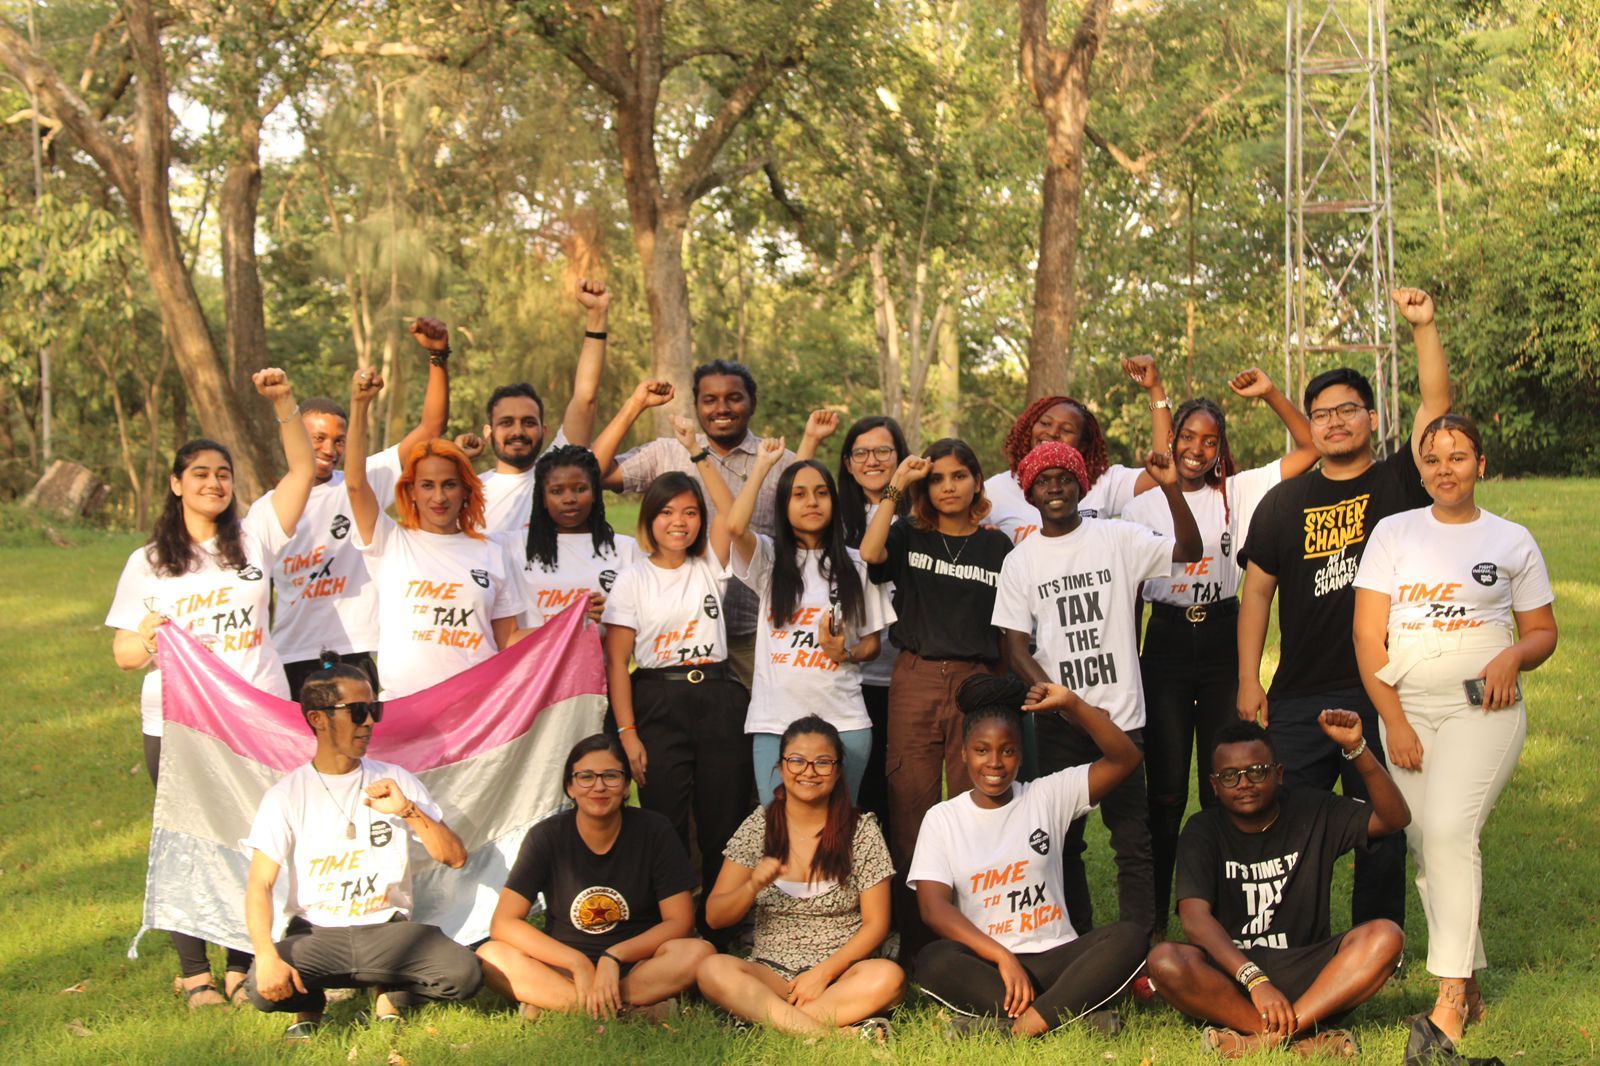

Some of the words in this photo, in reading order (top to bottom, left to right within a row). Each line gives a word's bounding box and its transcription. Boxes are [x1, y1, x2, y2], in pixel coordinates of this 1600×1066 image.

[282, 545, 328, 576] TIME
[908, 551, 934, 571] IGHT
[405, 579, 464, 601] TIME
[1037, 579, 1061, 600] IT'S
[1061, 571, 1094, 593] TIME
[1096, 568, 1112, 585] TO
[1171, 583, 1189, 594] TO
[1192, 581, 1223, 603] TAX
[1398, 583, 1463, 603] TIME
[176, 587, 234, 617] TIME
[1056, 591, 1104, 627] TAX
[212, 604, 254, 634] TAX
[412, 605, 429, 614] TO
[433, 606, 475, 627] TAX
[224, 627, 263, 652] RICH
[412, 630, 436, 641] THE
[437, 628, 484, 650] RICH
[770, 630, 789, 640] TO
[1065, 627, 1101, 653] THE
[656, 650, 673, 662] TO
[1059, 652, 1118, 691] RICH
[309, 849, 366, 878] TIME
[1225, 860, 1249, 880] IT'S
[1249, 857, 1285, 881] TIME
[341, 872, 379, 902] TAX
[970, 860, 1030, 894] TIME
[983, 894, 1001, 909] TO
[1007, 881, 1046, 913] TAX
[1241, 875, 1288, 916] TAX
[987, 919, 1015, 936] THE
